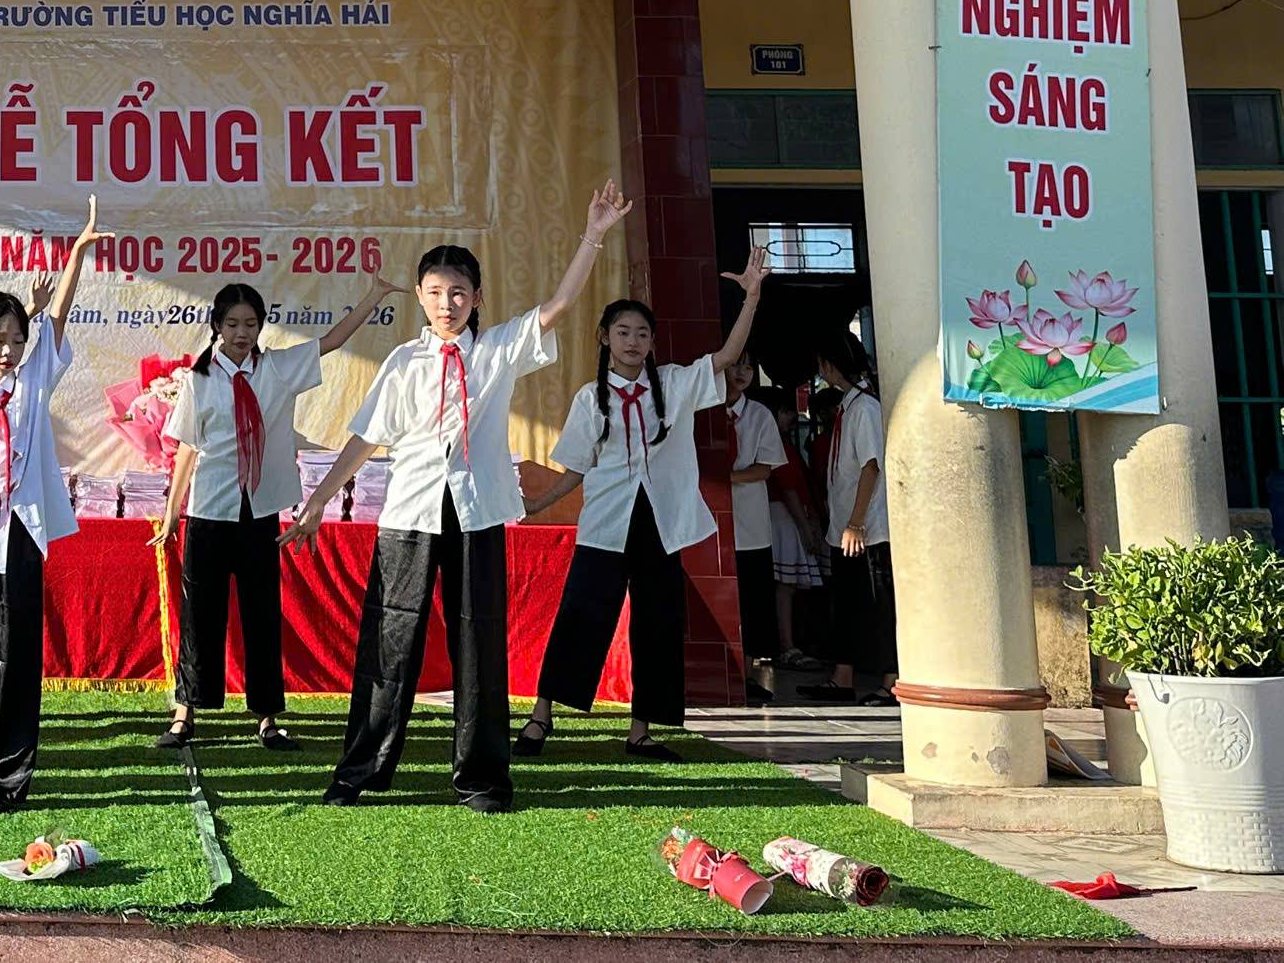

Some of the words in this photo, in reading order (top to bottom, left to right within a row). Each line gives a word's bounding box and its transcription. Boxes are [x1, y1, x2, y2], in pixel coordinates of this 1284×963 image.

[176, 5, 234, 31] HỌC
[243, 0, 332, 26] NGHĨA
[988, 62, 1108, 132] SÁNG
[66, 81, 258, 183] TỔNG
[289, 86, 422, 182] KẾT
[1008, 160, 1090, 228] TẠO
[96, 236, 163, 281] HỌC
[292, 236, 381, 273] 2026
[69, 304, 108, 325] âm,
[286, 306, 333, 325] năm
